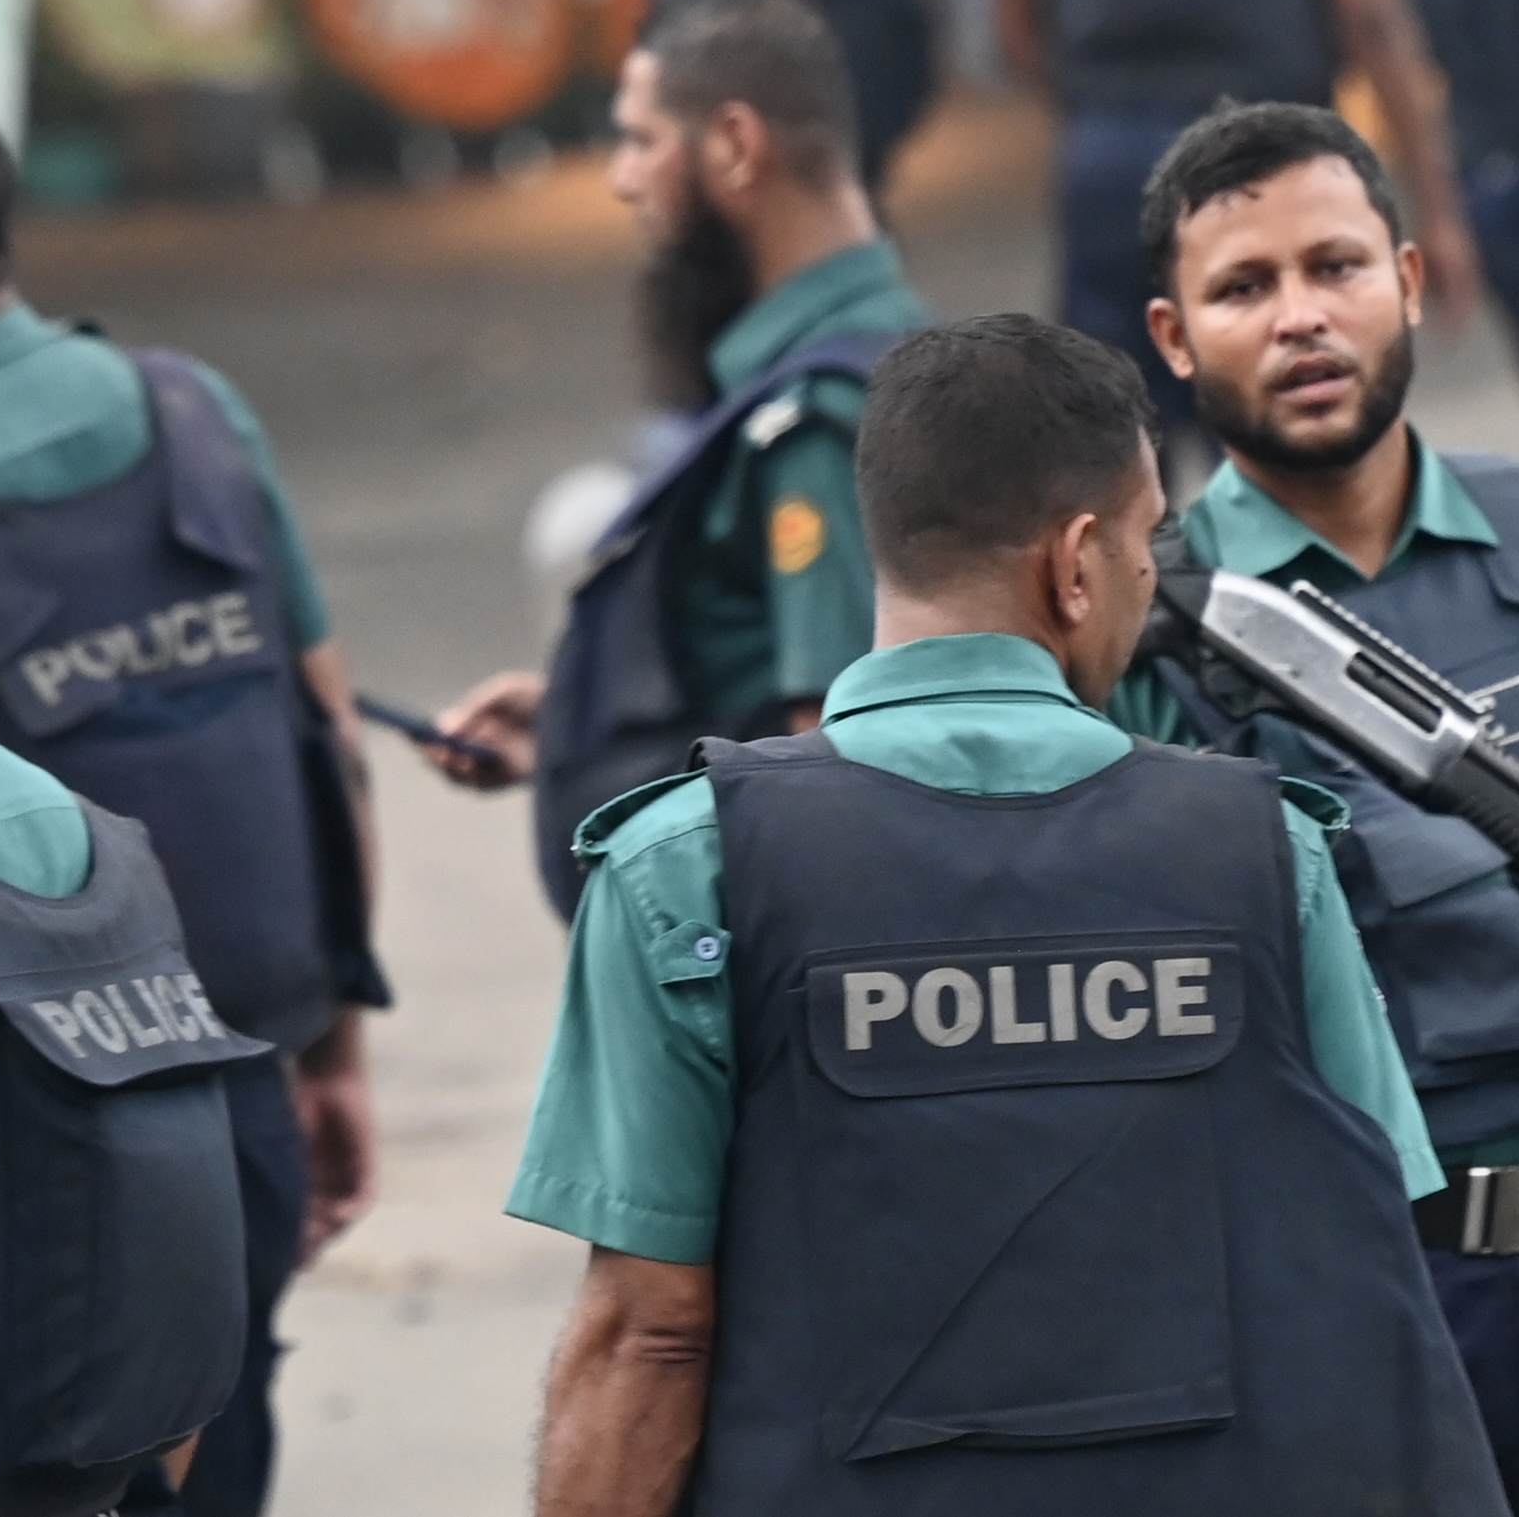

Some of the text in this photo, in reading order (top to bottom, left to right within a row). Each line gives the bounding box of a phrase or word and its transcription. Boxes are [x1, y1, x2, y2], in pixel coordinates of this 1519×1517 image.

[21, 591, 264, 705] POLICE
[31, 974, 226, 1059] POLICE
[842, 957, 1216, 1051] POLICE
